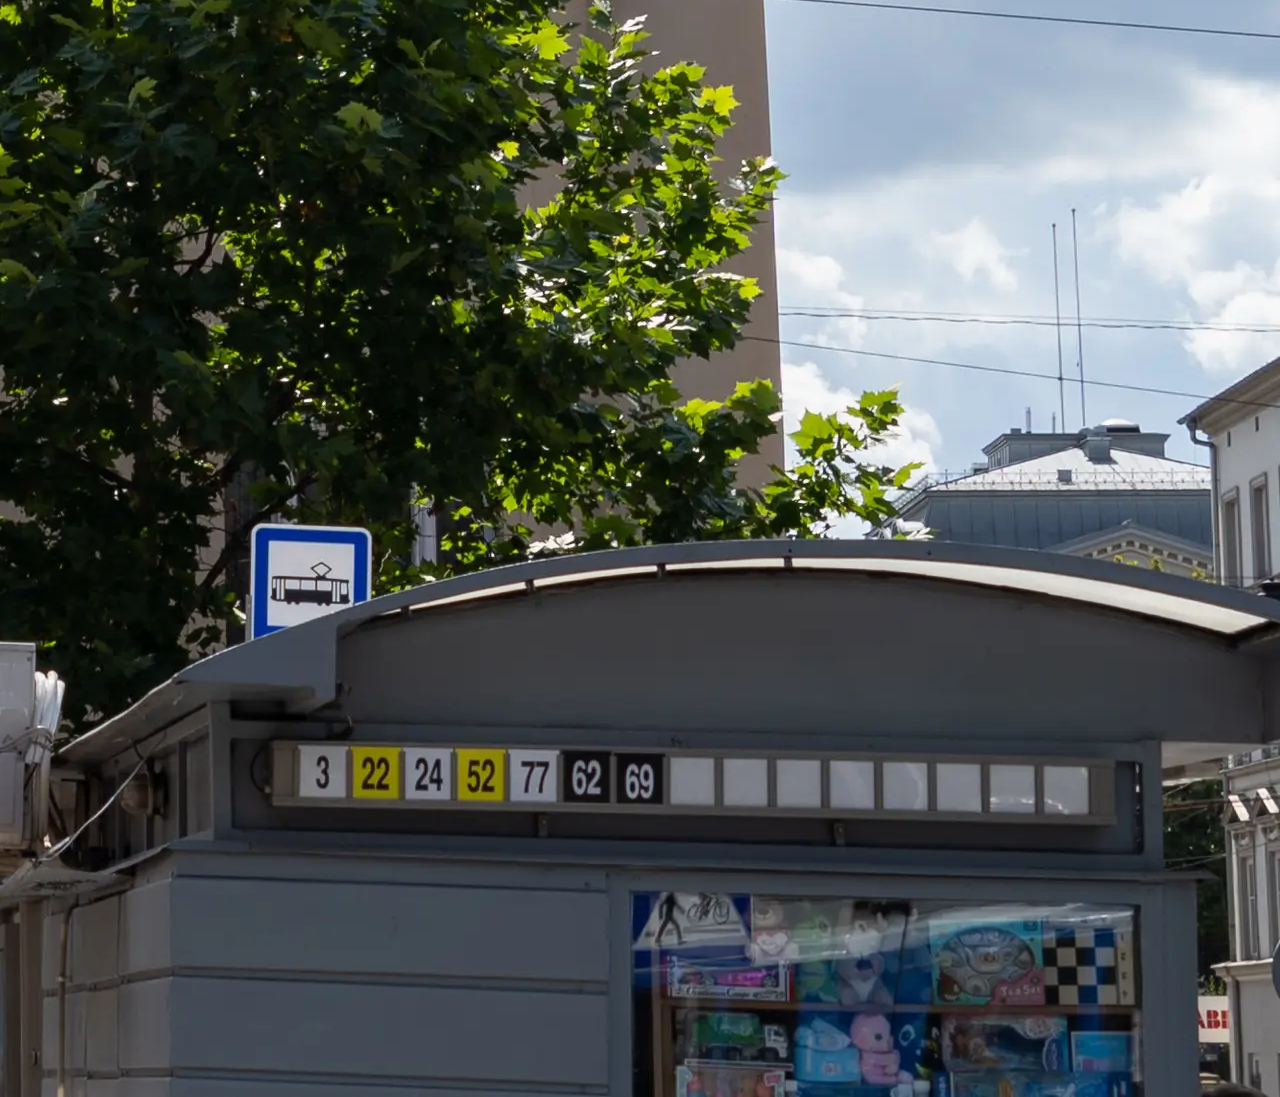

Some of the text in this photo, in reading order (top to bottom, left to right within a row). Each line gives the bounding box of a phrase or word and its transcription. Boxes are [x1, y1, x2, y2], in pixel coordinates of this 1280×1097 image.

[315, 755, 655, 800] 3 22 24 52 77 62 69
